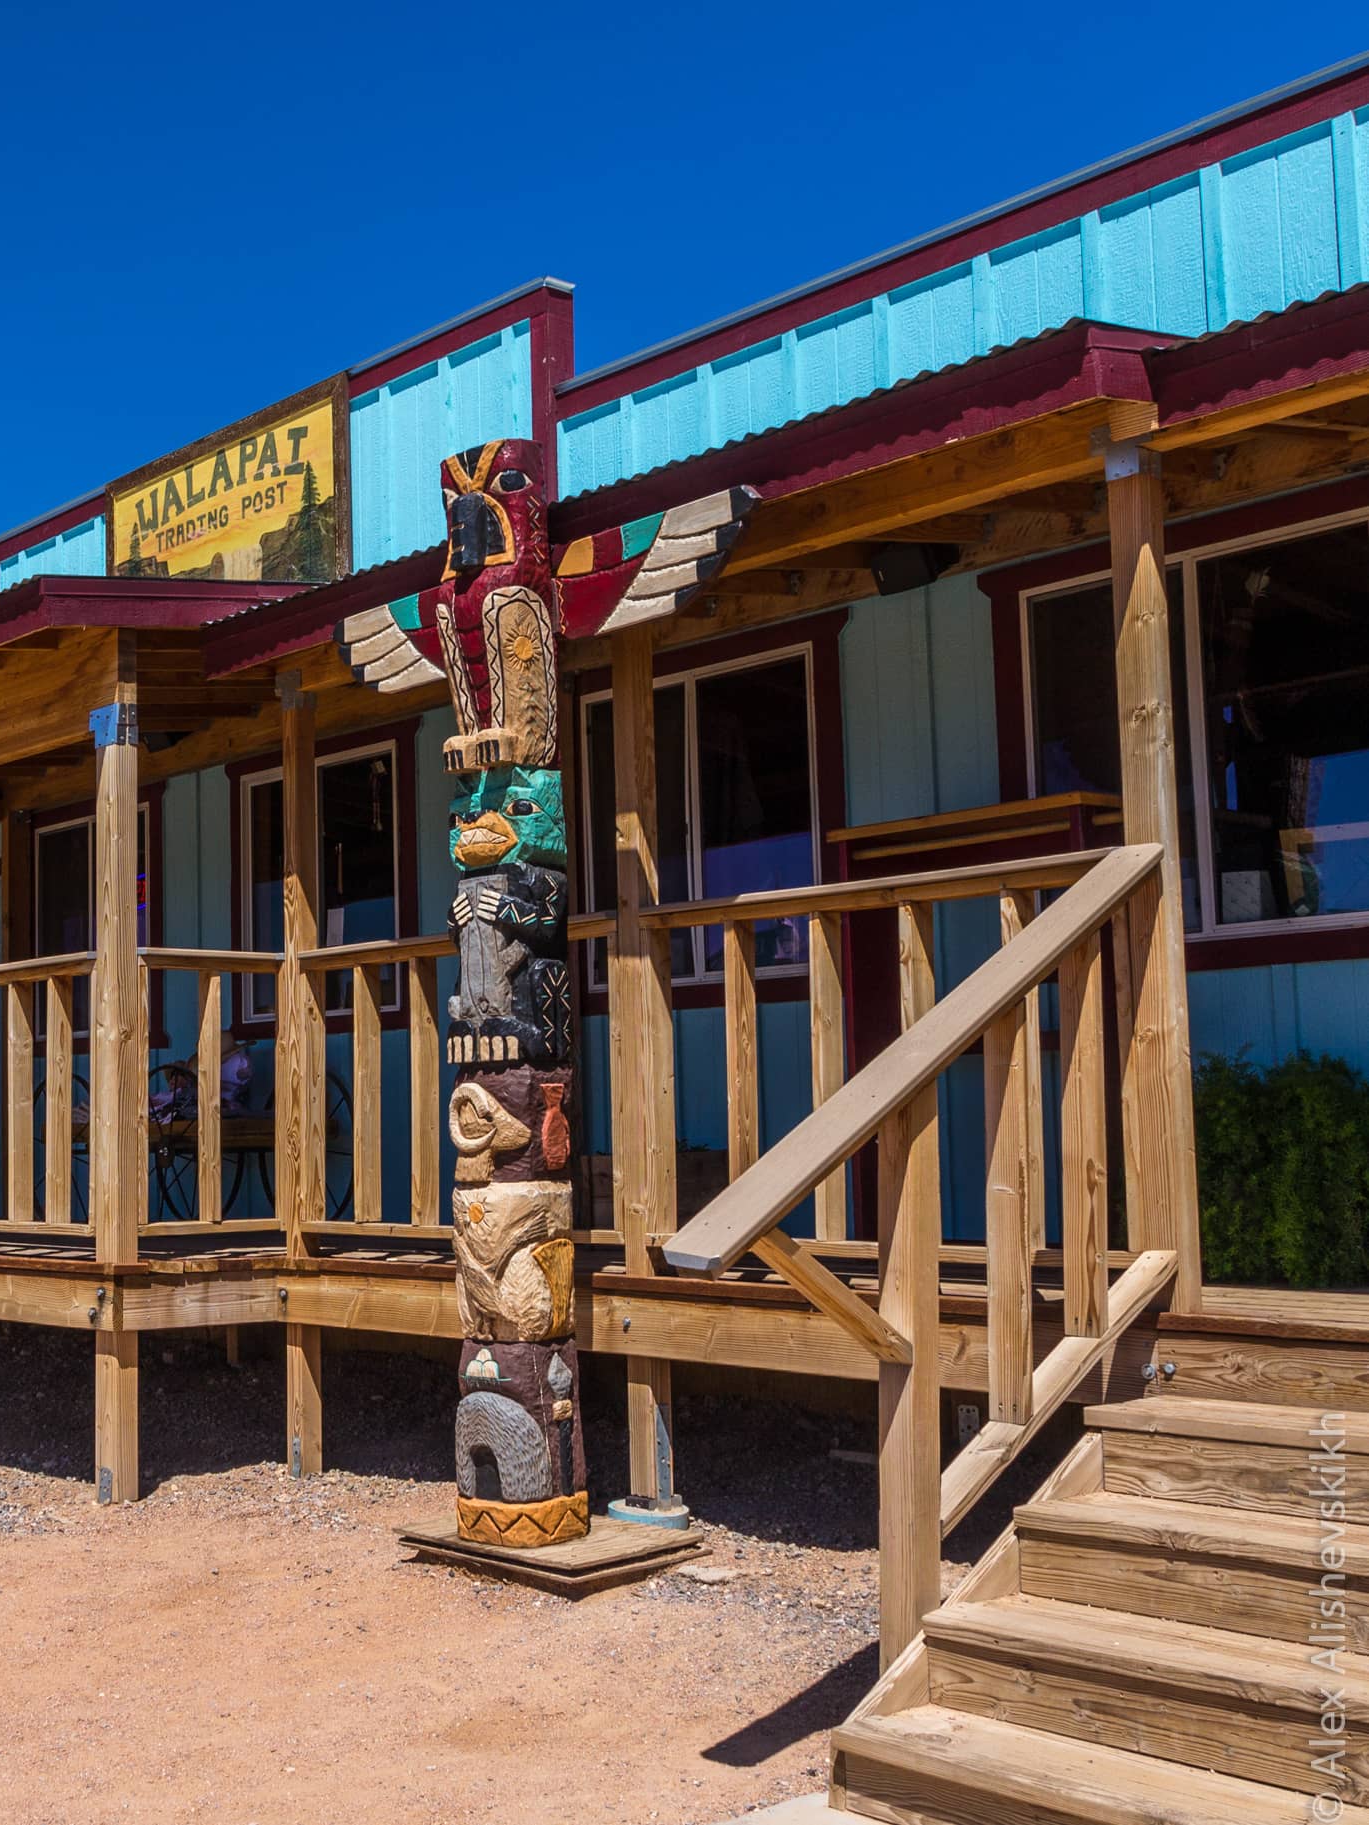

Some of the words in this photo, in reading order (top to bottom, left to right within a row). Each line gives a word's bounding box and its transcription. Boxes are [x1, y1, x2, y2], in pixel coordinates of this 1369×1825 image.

[134, 426, 308, 541] WALAPAI
[155, 505, 229, 554] TRADING
[241, 481, 288, 519] POST
